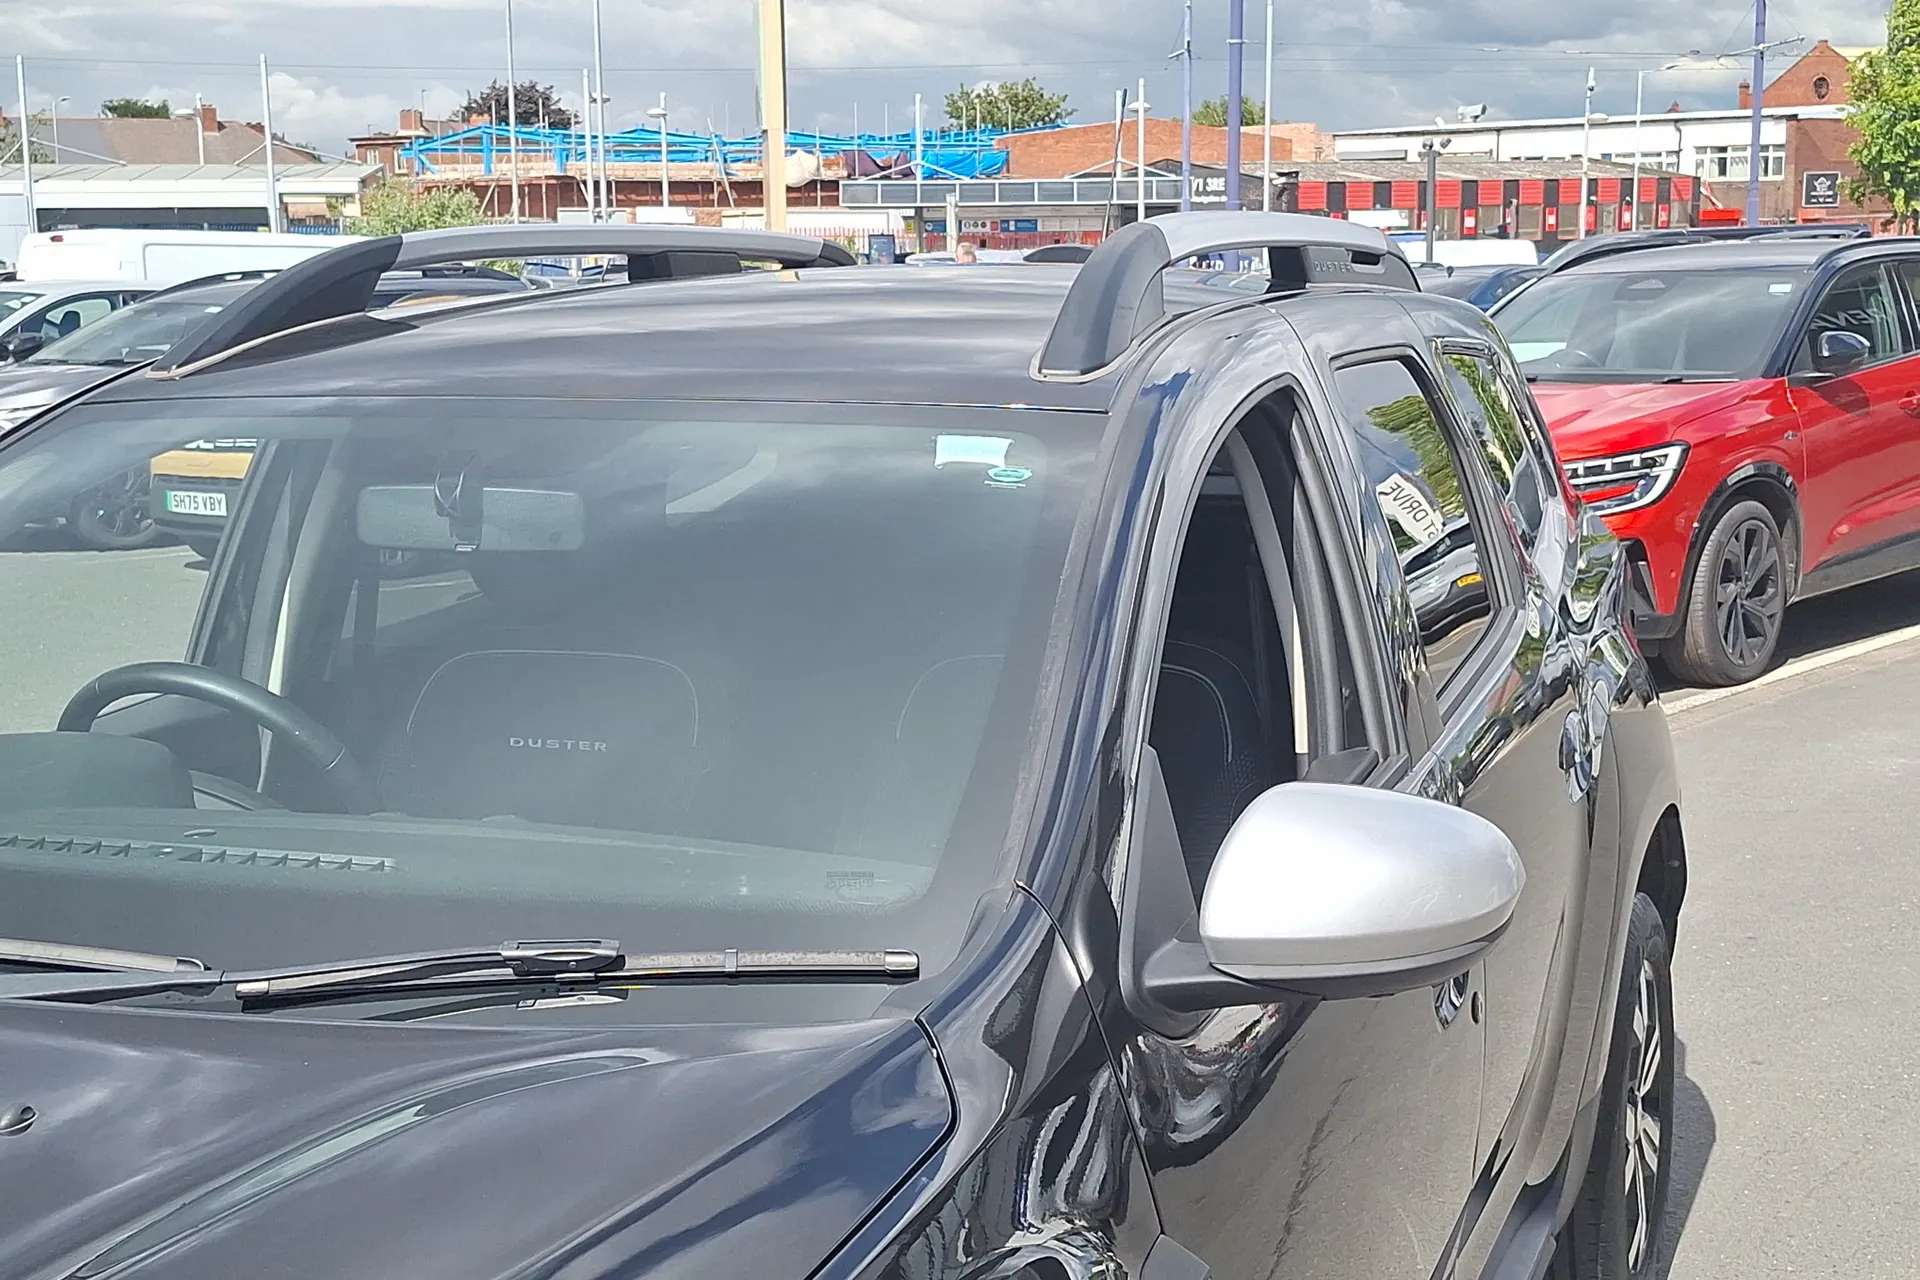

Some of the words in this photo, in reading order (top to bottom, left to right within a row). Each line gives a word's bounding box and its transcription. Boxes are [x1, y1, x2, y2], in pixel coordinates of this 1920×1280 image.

[1313, 261, 1355, 272] DUSTER
[173, 494, 200, 511] SH75
[202, 496, 223, 512] VBY
[509, 737, 608, 752] DUSTER
